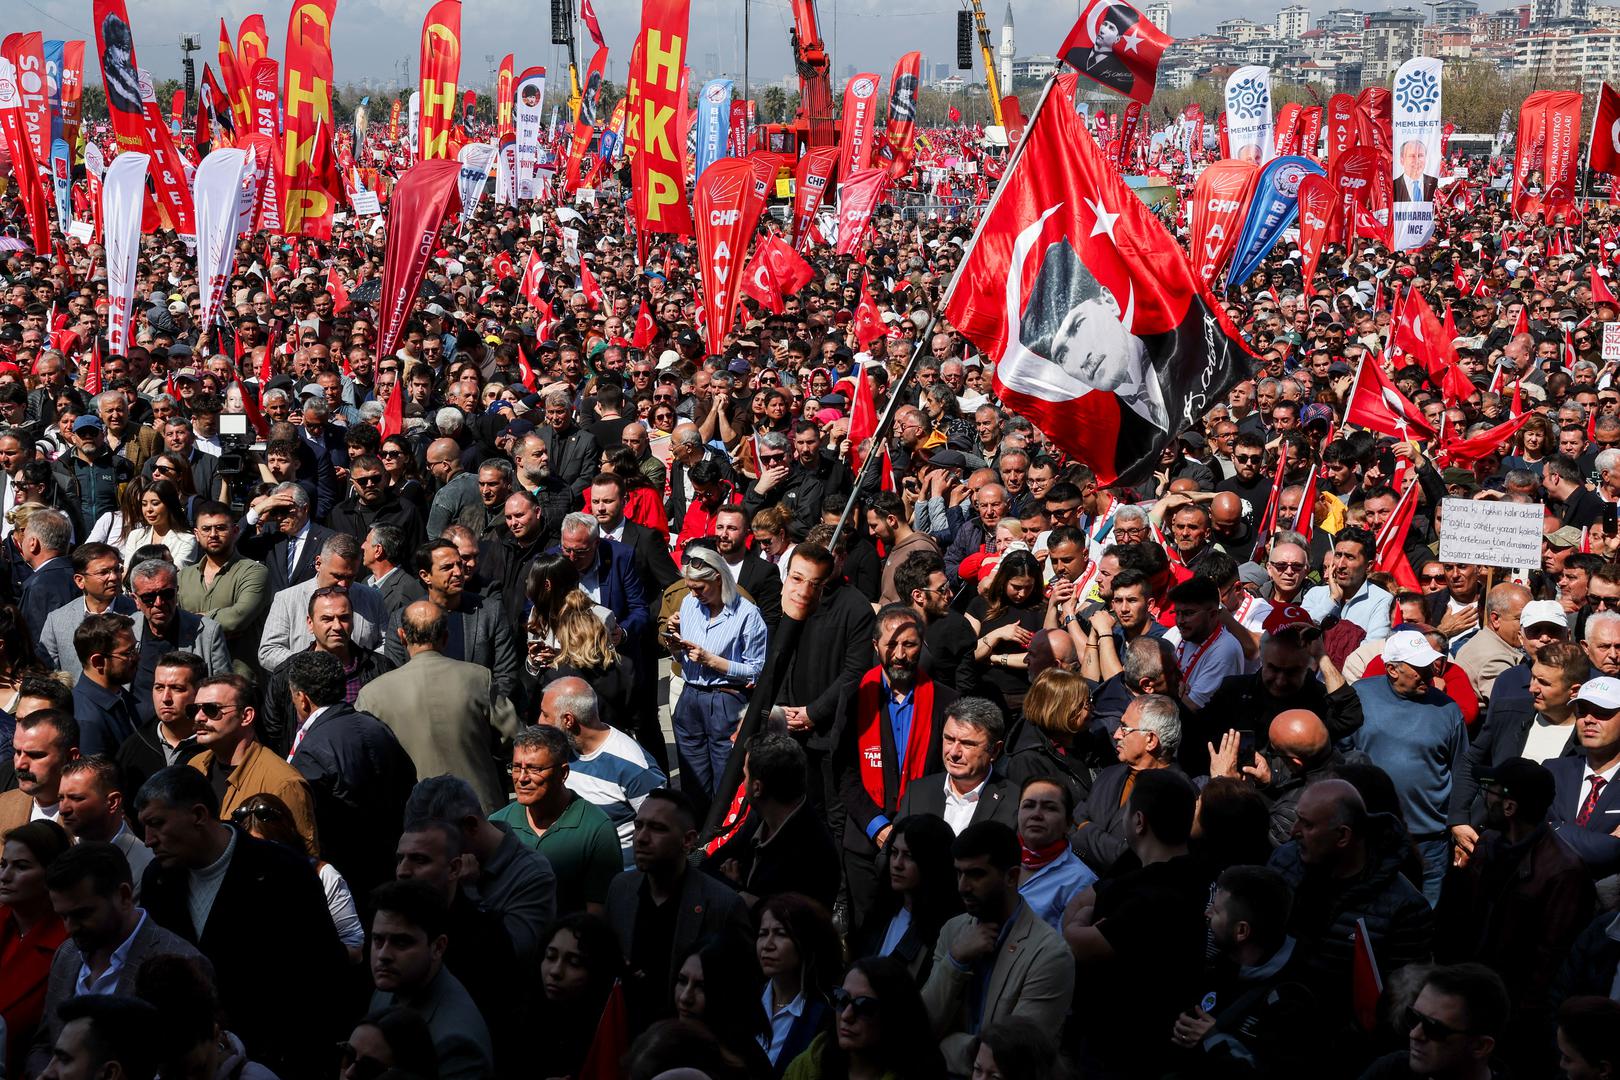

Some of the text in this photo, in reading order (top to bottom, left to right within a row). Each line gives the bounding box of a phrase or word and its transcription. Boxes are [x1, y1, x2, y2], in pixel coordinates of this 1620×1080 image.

[20, 54, 44, 109] SOL
[62, 69, 77, 81] OL
[256, 88, 276, 102] CHP
[1335, 112, 1350, 120] CHP
[646, 28, 682, 222] HKP
[1230, 123, 1272, 135] MEMLEKET
[1395, 120, 1440, 128] MEMLEKET
[1562, 115, 1572, 148] KOLLARI
[285, 68, 330, 234] HKP
[1550, 111, 1561, 182] CHP ARNAVUTKÖY
[1521, 157, 1529, 177] CHP
[461, 168, 487, 181] CHP
[807, 174, 826, 187] CHP
[1340, 175, 1367, 188] CHP
[1207, 198, 1240, 213] CHP
[711, 210, 741, 226] CHP
[847, 209, 871, 221] CHP
[1407, 223, 1423, 236] İNCE
